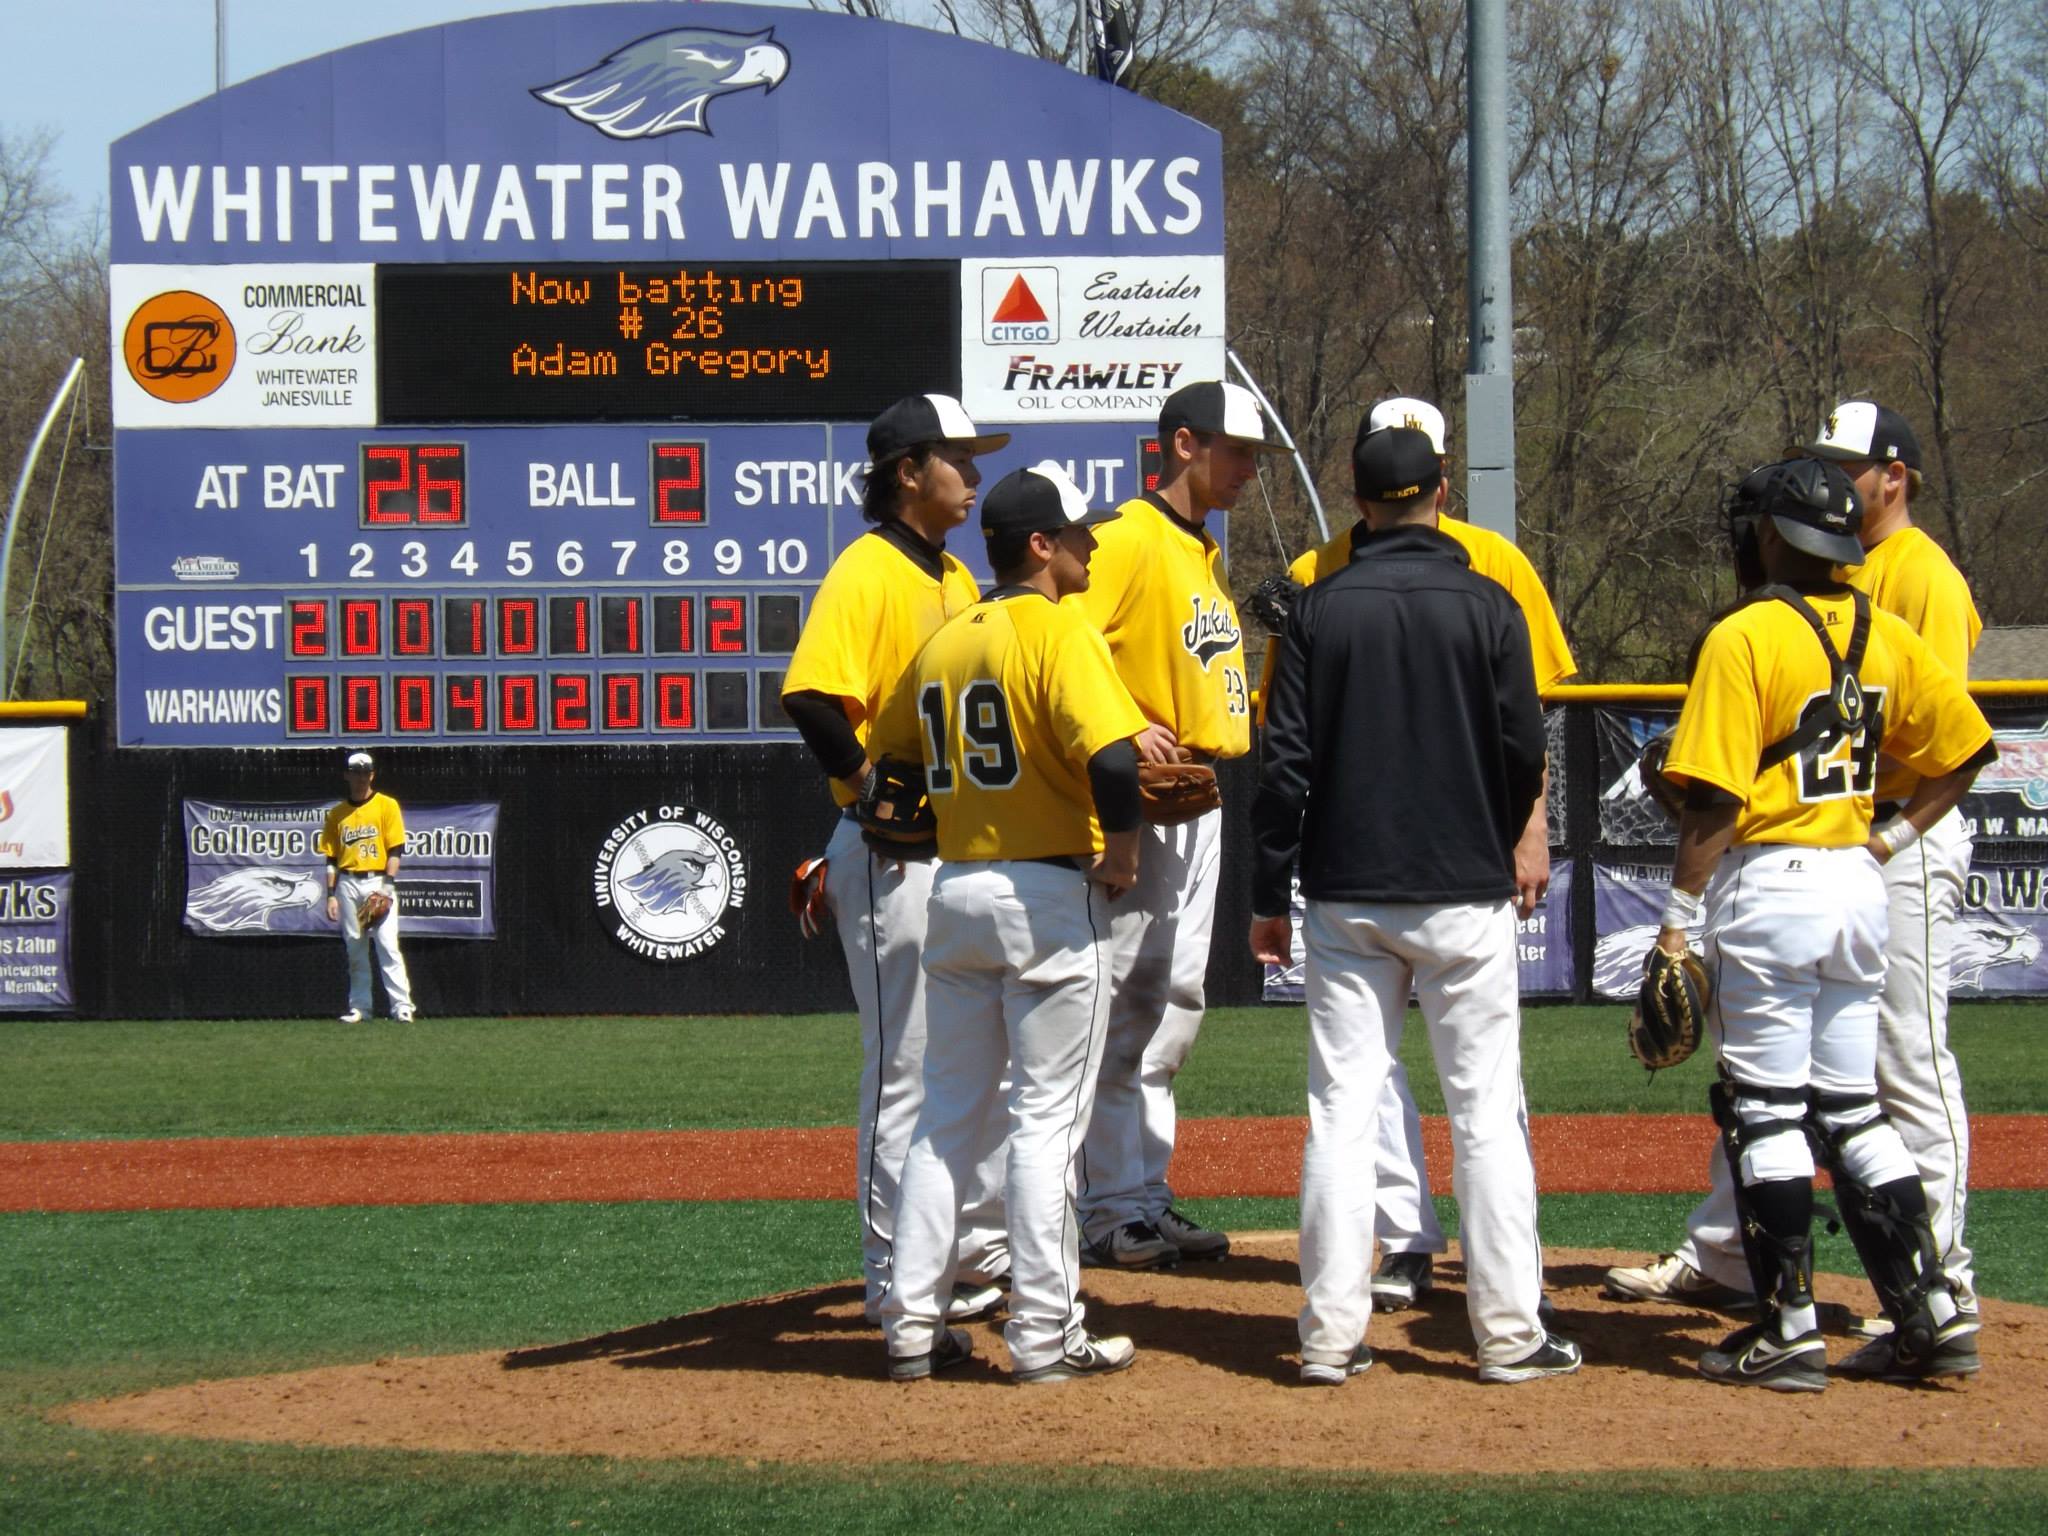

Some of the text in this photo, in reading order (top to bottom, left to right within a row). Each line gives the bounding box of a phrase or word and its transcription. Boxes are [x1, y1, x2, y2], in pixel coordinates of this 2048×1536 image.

[129, 156, 1203, 243] WHITEWATER WARHAWKS
[244, 284, 367, 308] COMMERCIAL
[511, 270, 802, 307] Now batting
[1083, 270, 1202, 301] Eastsider
[245, 310, 366, 355] Bank
[619, 305, 723, 339] # 26
[991, 326, 1050, 341] CITGO
[1079, 310, 1202, 338] Westsider
[256, 368, 358, 385] WHITEWATER
[512, 341, 830, 379] Adam Gregory
[1003, 355, 1183, 391] FRAWLEY
[262, 390, 352, 407] JANESVILLE
[1018, 395, 1168, 410] OIL COMPANY
[195, 464, 345, 508] AT BAT
[367, 447, 462, 523] 26
[528, 462, 636, 507] BALL
[658, 447, 701, 522] 2
[1037, 458, 1124, 504] UT
[300, 538, 808, 578] 1 2 3 4 5 6 7 8 9 10
[144, 605, 282, 651] GUEST
[294, 602, 326, 655] 2
[346, 602, 378, 654] 0
[399, 602, 430, 654] 0
[504, 601, 535, 653] 0
[711, 599, 742, 652] 2
[145, 688, 282, 725] WARHAWKS
[294, 676, 692, 731] 0 0 0 4 0 2 0 0
[917, 679, 1022, 795] 19
[191, 824, 306, 860] College
[401, 826, 491, 858] cation
[593, 805, 747, 908] UNIVERSITY OF WISCONSIN
[401, 898, 475, 909] HITEWATER
[15, 935, 57, 954] Zahn
[615, 924, 726, 960] WHITEWATER
